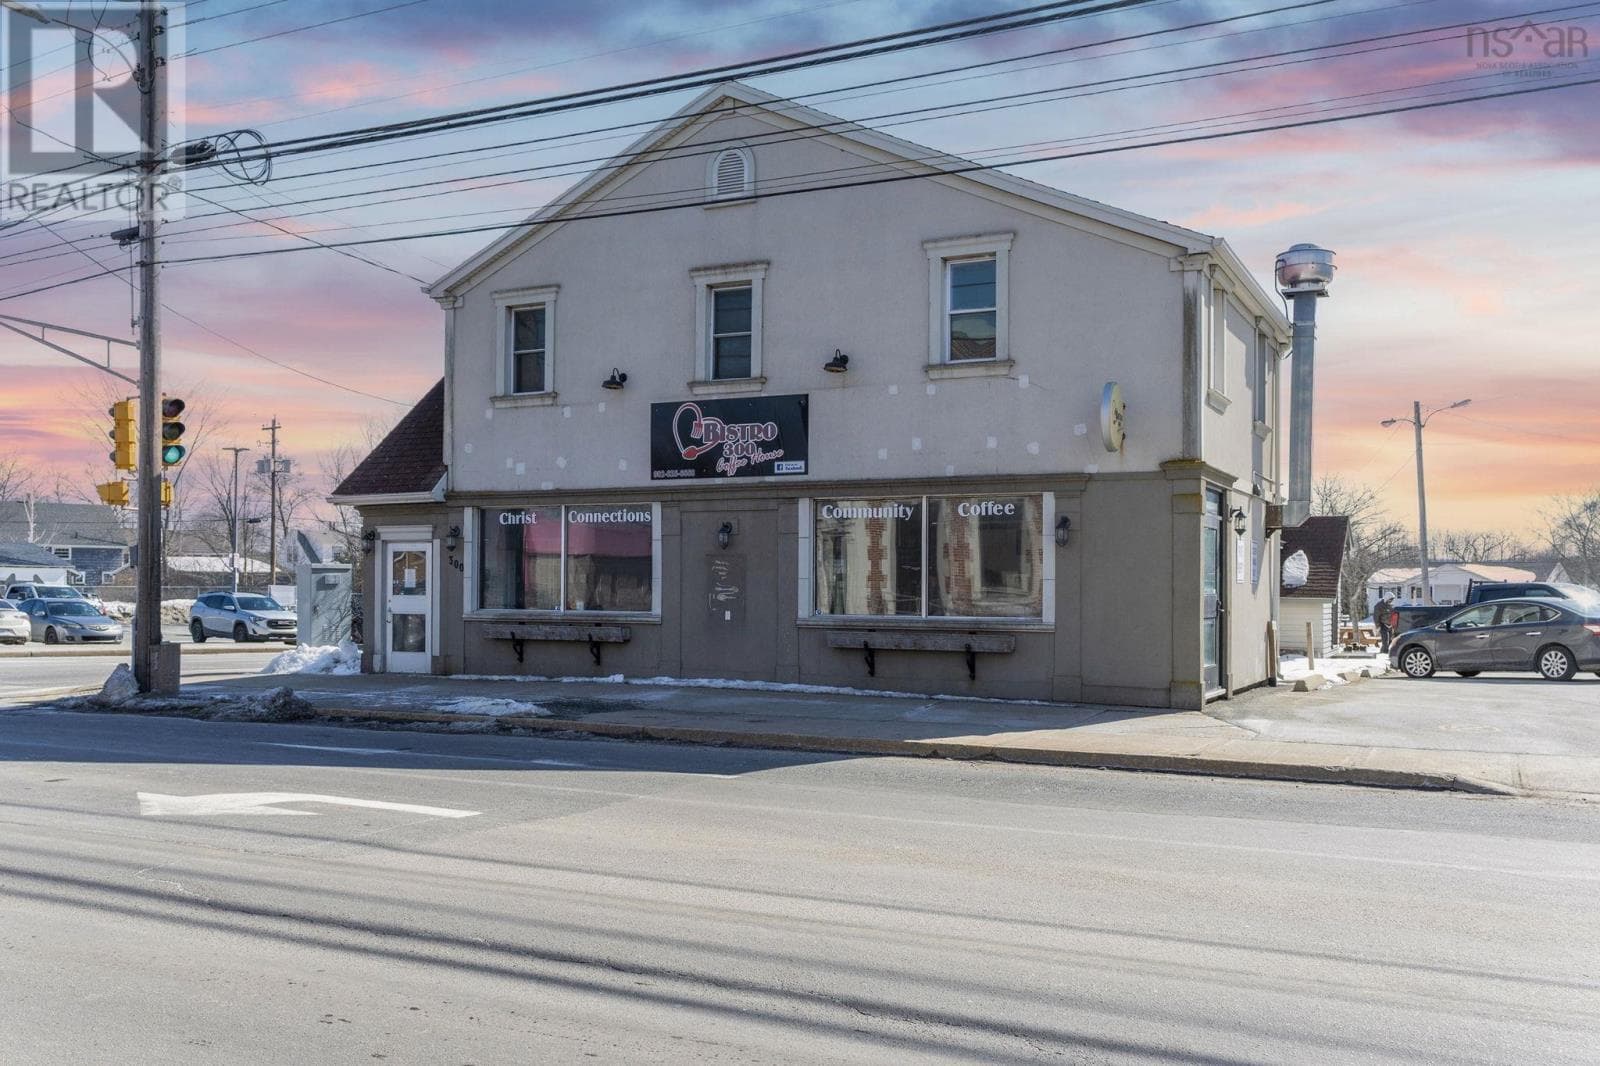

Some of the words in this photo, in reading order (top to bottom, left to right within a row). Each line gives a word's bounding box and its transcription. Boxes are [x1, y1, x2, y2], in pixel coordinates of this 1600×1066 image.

[723, 441, 757, 457] 300
[716, 455, 748, 476] Coffee
[751, 448, 784, 465] House
[499, 511, 537, 525] Christ
[568, 508, 651, 524] Connections
[821, 503, 914, 521] Community
[957, 502, 1016, 517] Coffee
